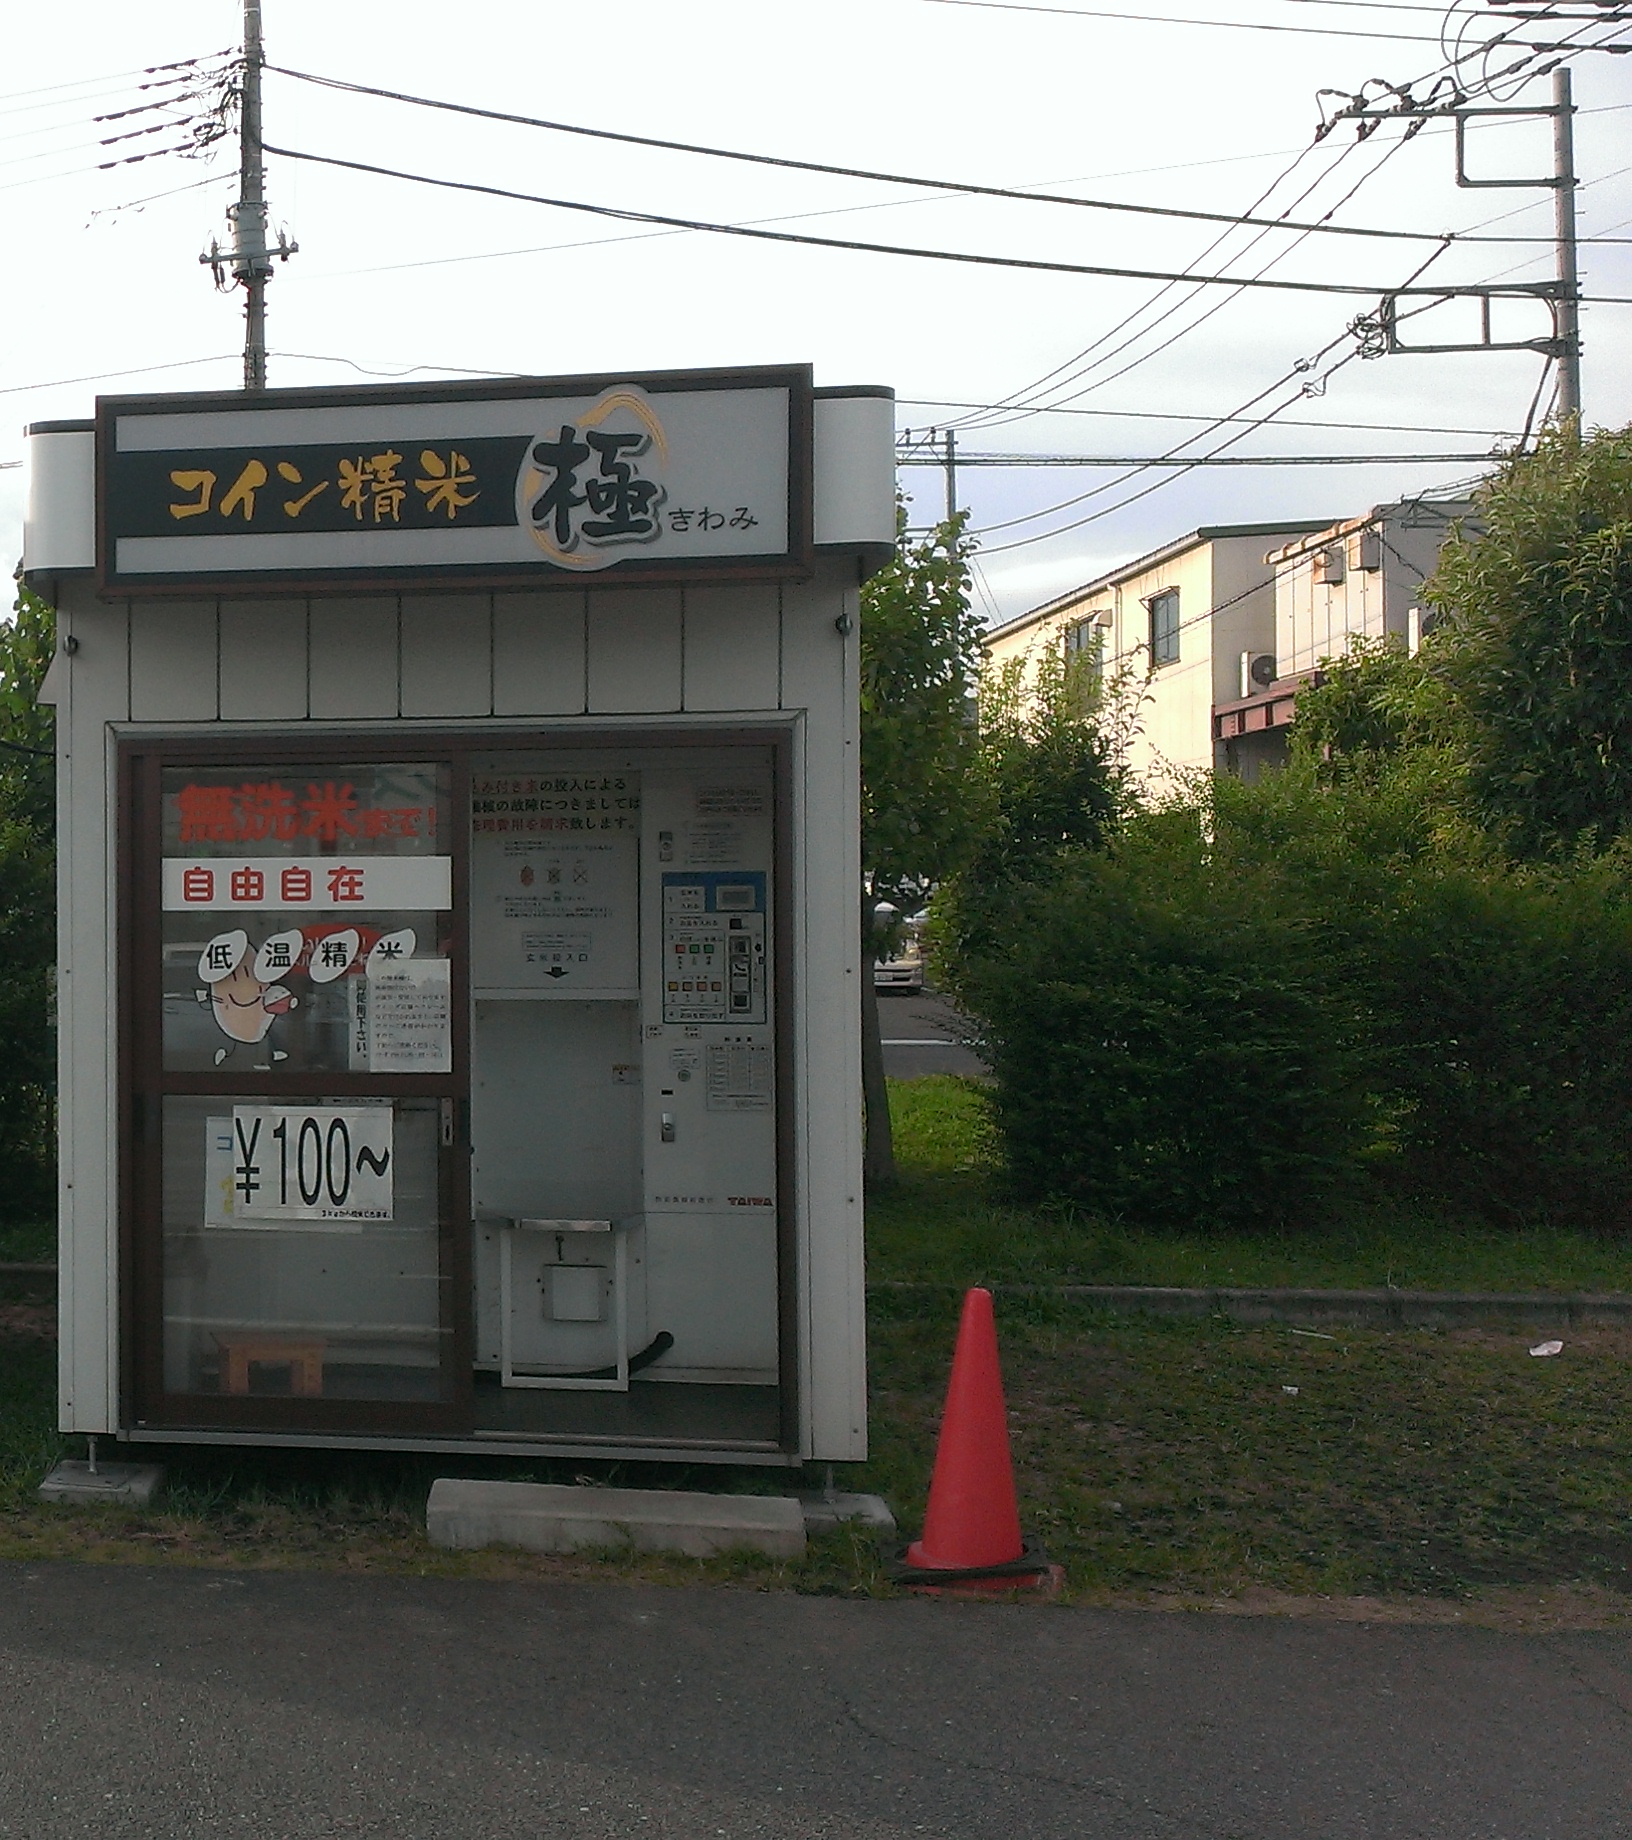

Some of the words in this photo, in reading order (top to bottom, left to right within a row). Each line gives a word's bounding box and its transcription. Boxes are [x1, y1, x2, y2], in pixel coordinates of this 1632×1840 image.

[169, 449, 481, 522] コイン精米
[531, 425, 656, 546] 極
[667, 504, 759, 533] きわみ
[183, 866, 365, 902] 自由自在
[206, 941, 404, 970] 低温精米
